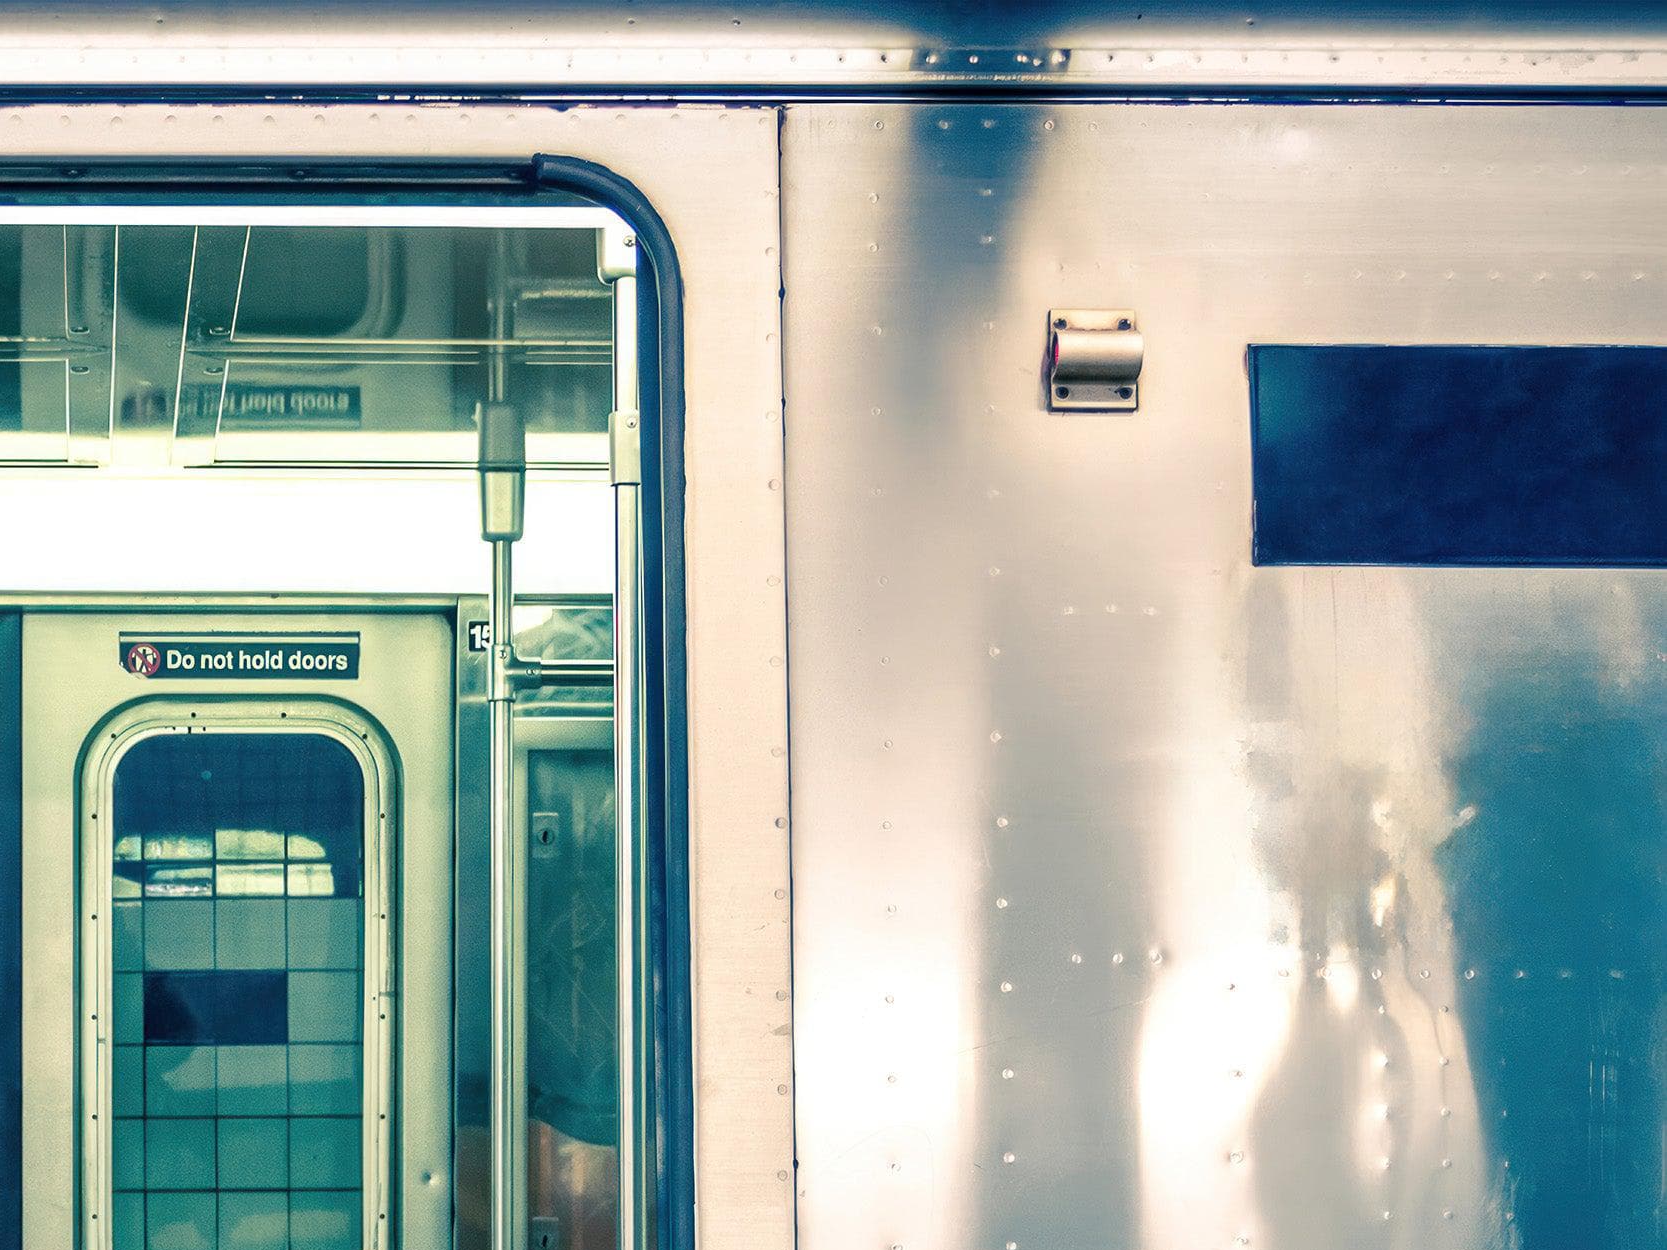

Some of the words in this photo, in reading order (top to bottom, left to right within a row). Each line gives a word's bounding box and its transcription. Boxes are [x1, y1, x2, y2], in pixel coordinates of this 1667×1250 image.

[166, 650, 195, 670] Do
[200, 651, 234, 670] not
[238, 649, 284, 671] hold
[288, 649, 349, 671] doors
